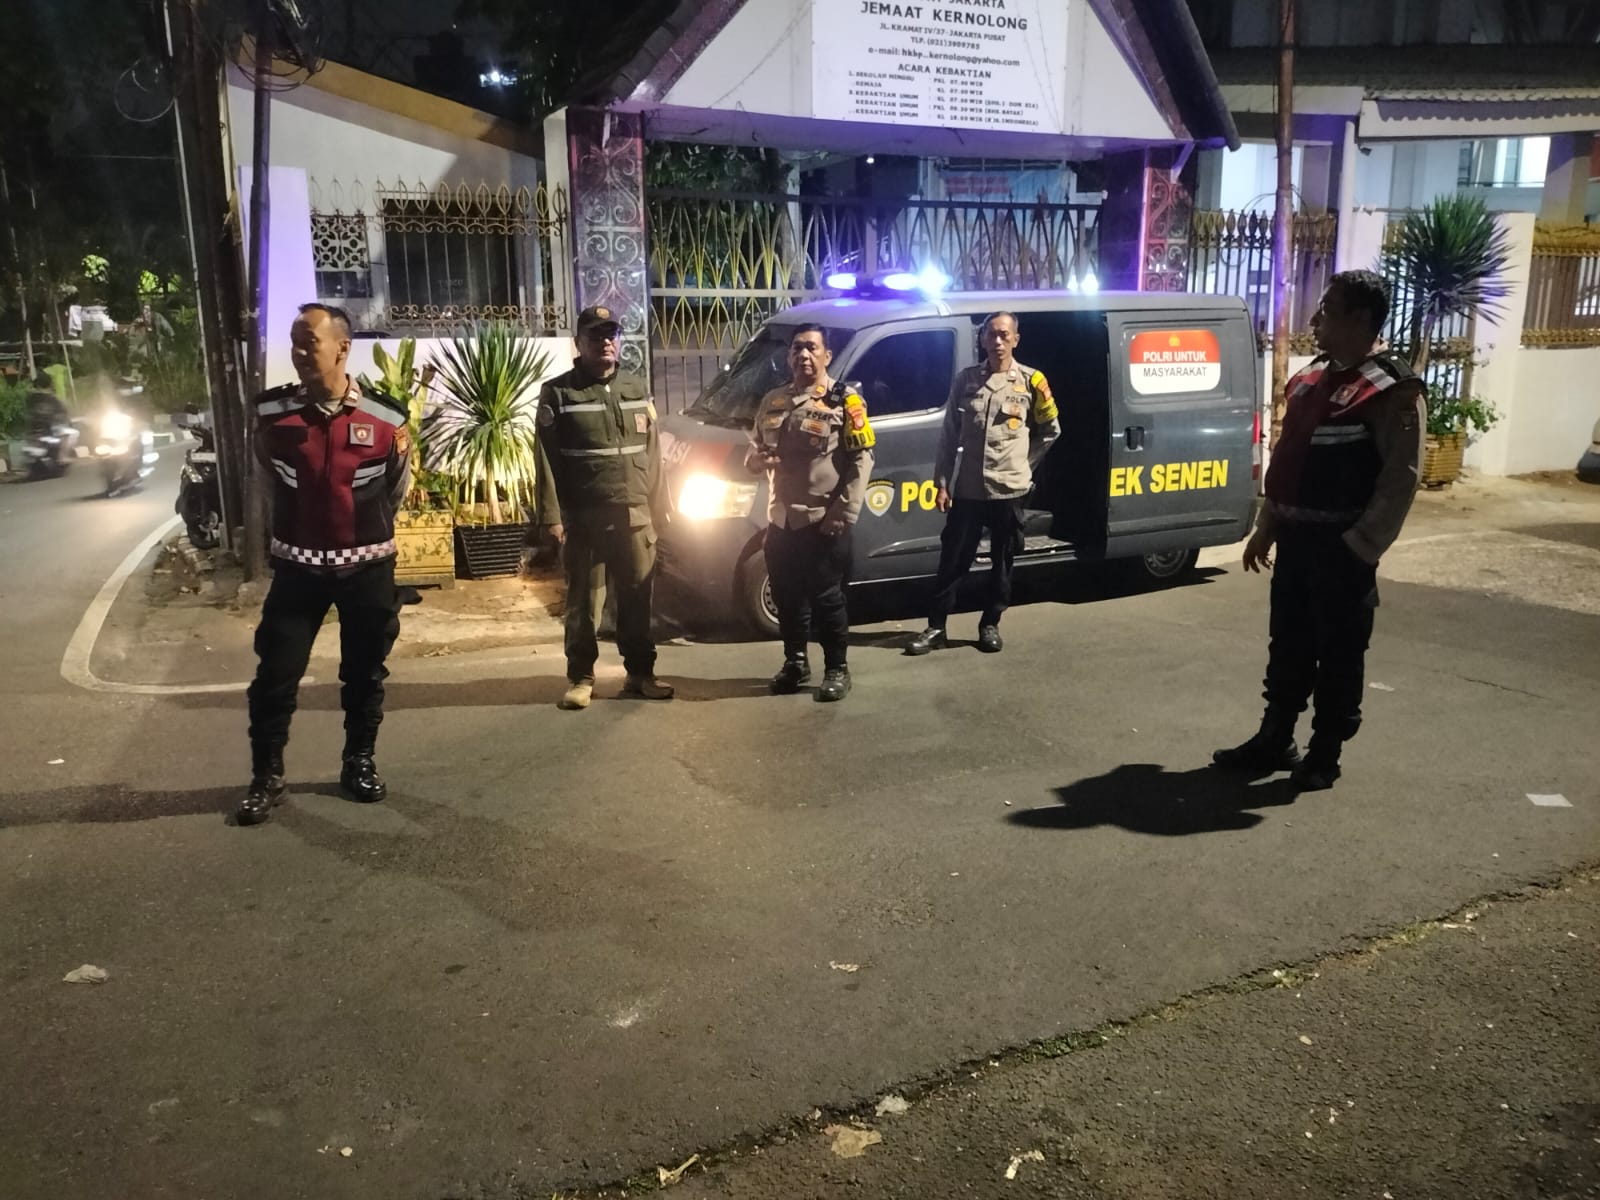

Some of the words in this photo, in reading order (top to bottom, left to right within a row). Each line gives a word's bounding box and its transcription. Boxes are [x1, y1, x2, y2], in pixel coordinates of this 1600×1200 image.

[861, 1, 922, 19] JEMAAT
[933, 9, 1028, 30] KERNOLONG
[891, 24, 923, 34] KRAMAT
[984, 33, 1006, 42] PUSAT
[856, 71, 887, 79] SEKOLAH
[898, 63, 931, 74] ACARA
[936, 66, 992, 79] KEBAKTIAN
[856, 90, 897, 98] KEBAKTIAN
[856, 99, 897, 107] KEBAKTIAN
[856, 108, 897, 117] KEBAKTIAN
[1143, 352, 1173, 362] POLRI
[1174, 351, 1207, 361] UNTUK
[1143, 367, 1208, 377] MASYARAKAT
[1150, 460, 1228, 493] SENEN
